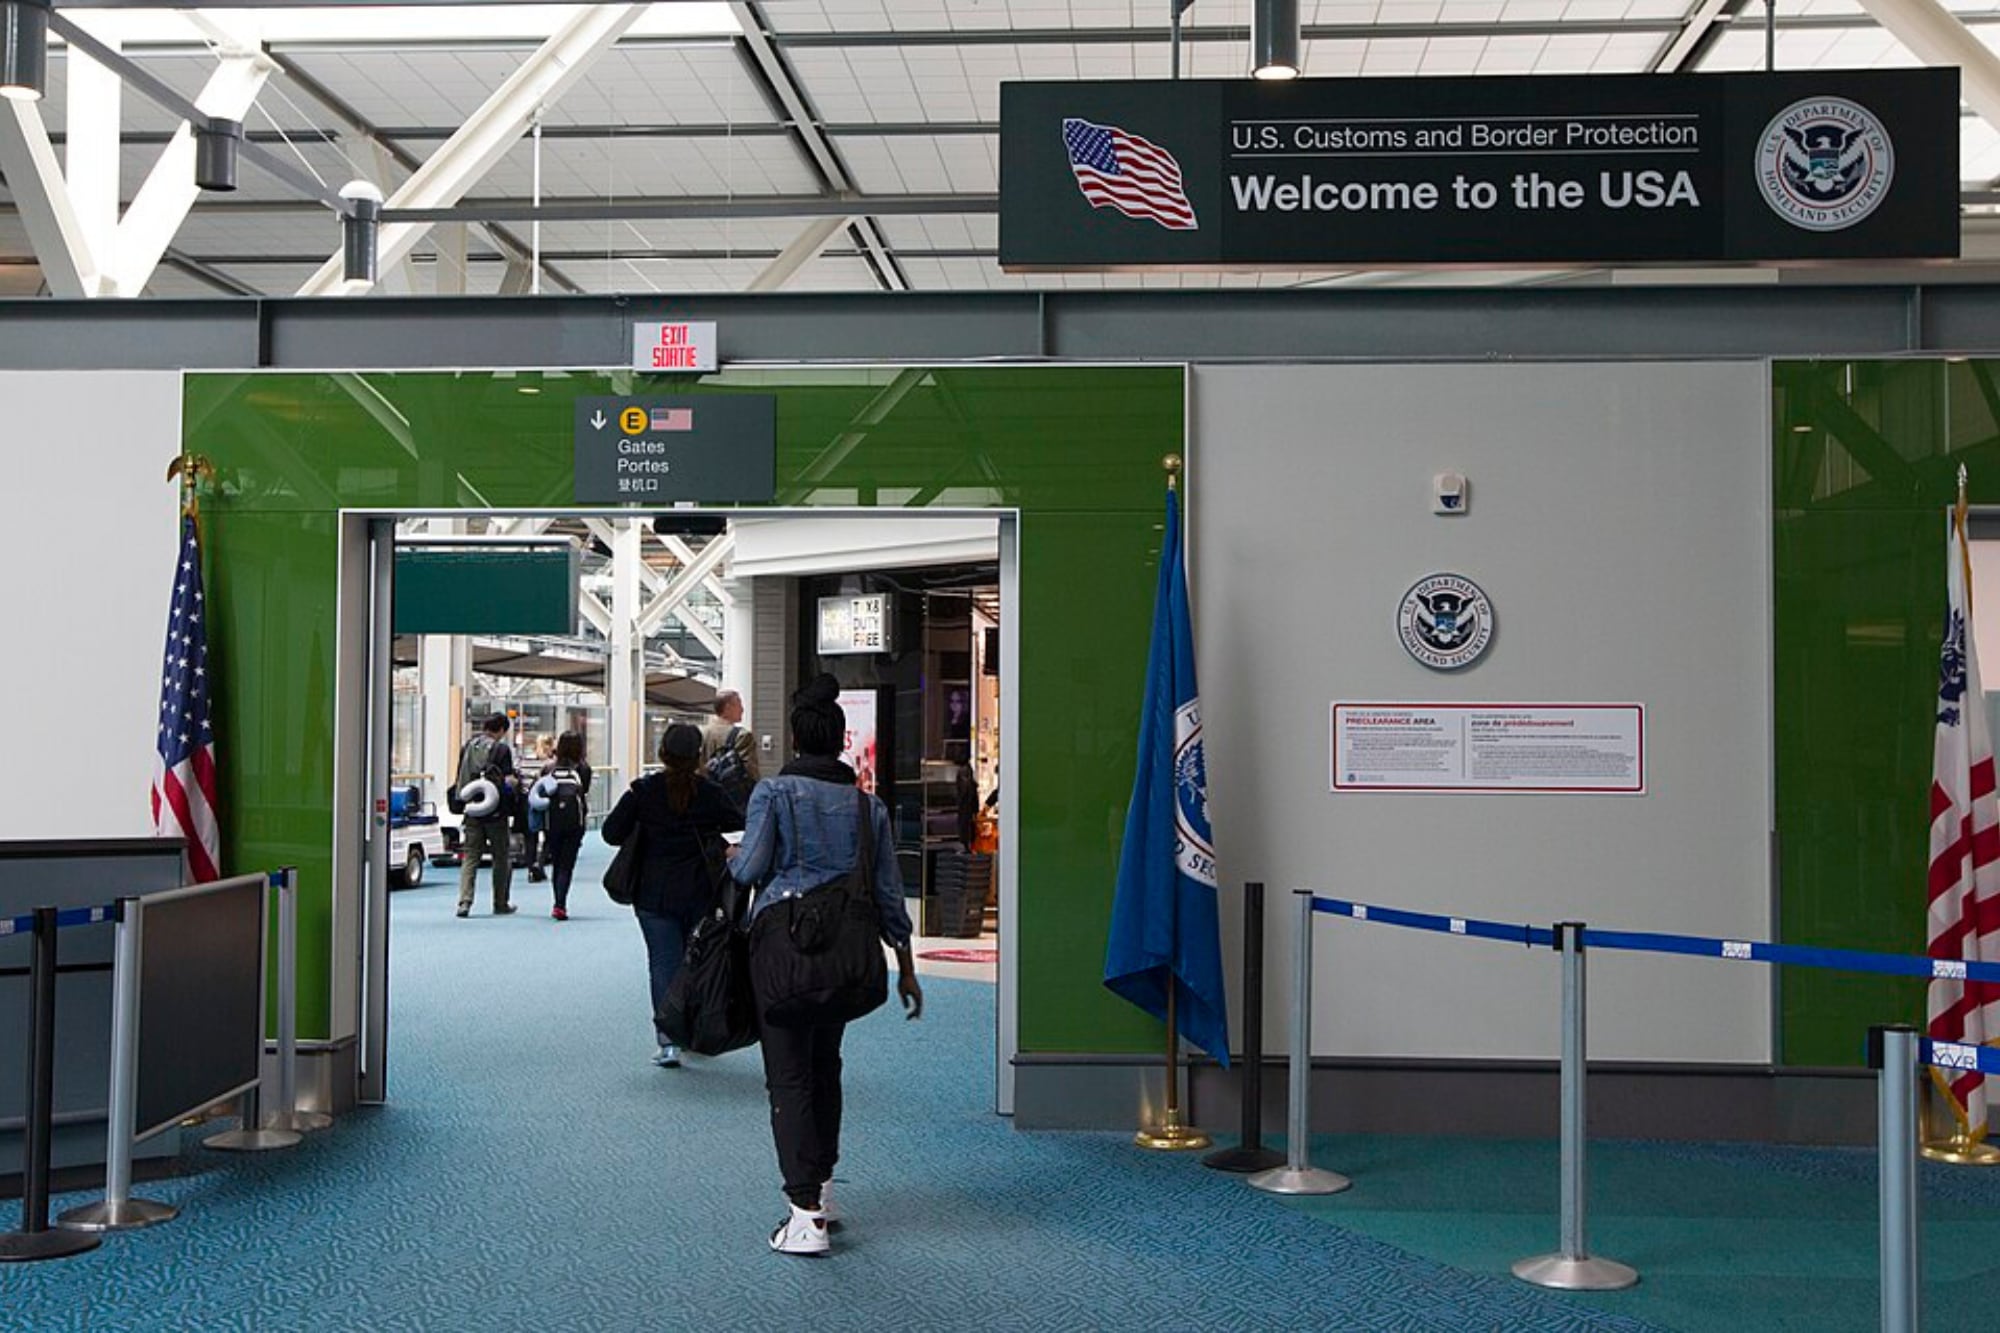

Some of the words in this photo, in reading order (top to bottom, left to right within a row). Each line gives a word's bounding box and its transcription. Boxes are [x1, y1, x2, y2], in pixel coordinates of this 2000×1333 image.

[1232, 126, 1285, 149] U.S.
[1293, 126, 1408, 149] Customs
[1414, 124, 1462, 147] and
[1471, 124, 1558, 146] Border
[1566, 122, 1698, 145] Protection
[1230, 174, 1439, 211] Welcome
[1452, 174, 1498, 209] to
[1511, 172, 1585, 209] the
[1600, 170, 1700, 208] USA
[1765, 169, 1827, 221] HOMELAND
[1831, 169, 1885, 220] SECURITY
[661, 325, 689, 346] EXIT
[652, 347, 696, 368] SORTIE
[627, 412, 640, 430] E
[617, 438, 665, 455] Gates
[617, 458, 670, 474] Portes
[1932, 1050, 1976, 1070] YVR
